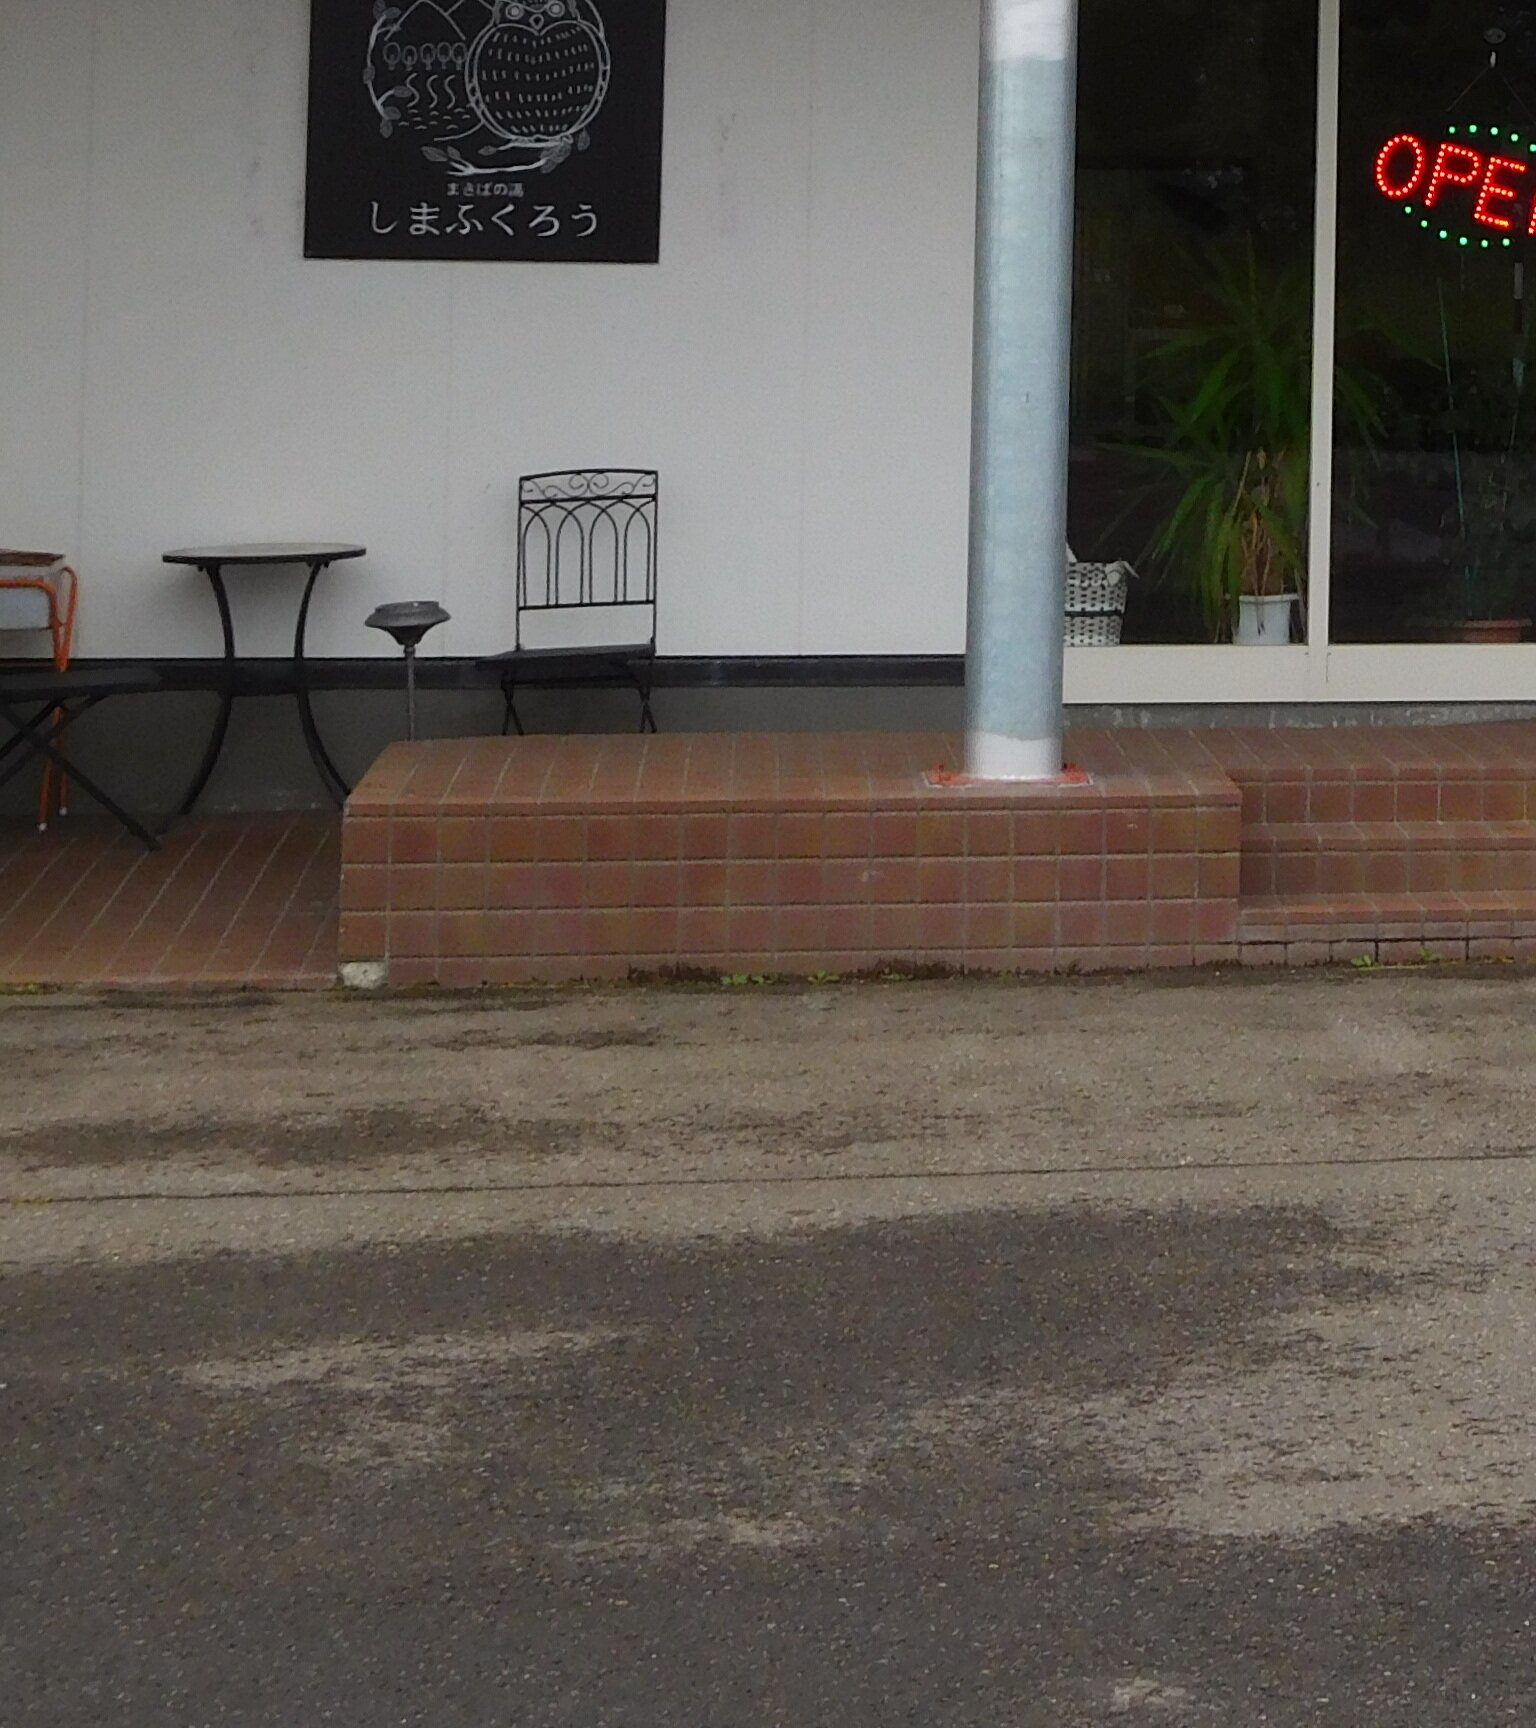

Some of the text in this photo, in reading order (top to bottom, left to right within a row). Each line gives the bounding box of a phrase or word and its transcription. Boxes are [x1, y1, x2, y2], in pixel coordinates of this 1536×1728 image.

[369, 201, 600, 237] しまふくろう
